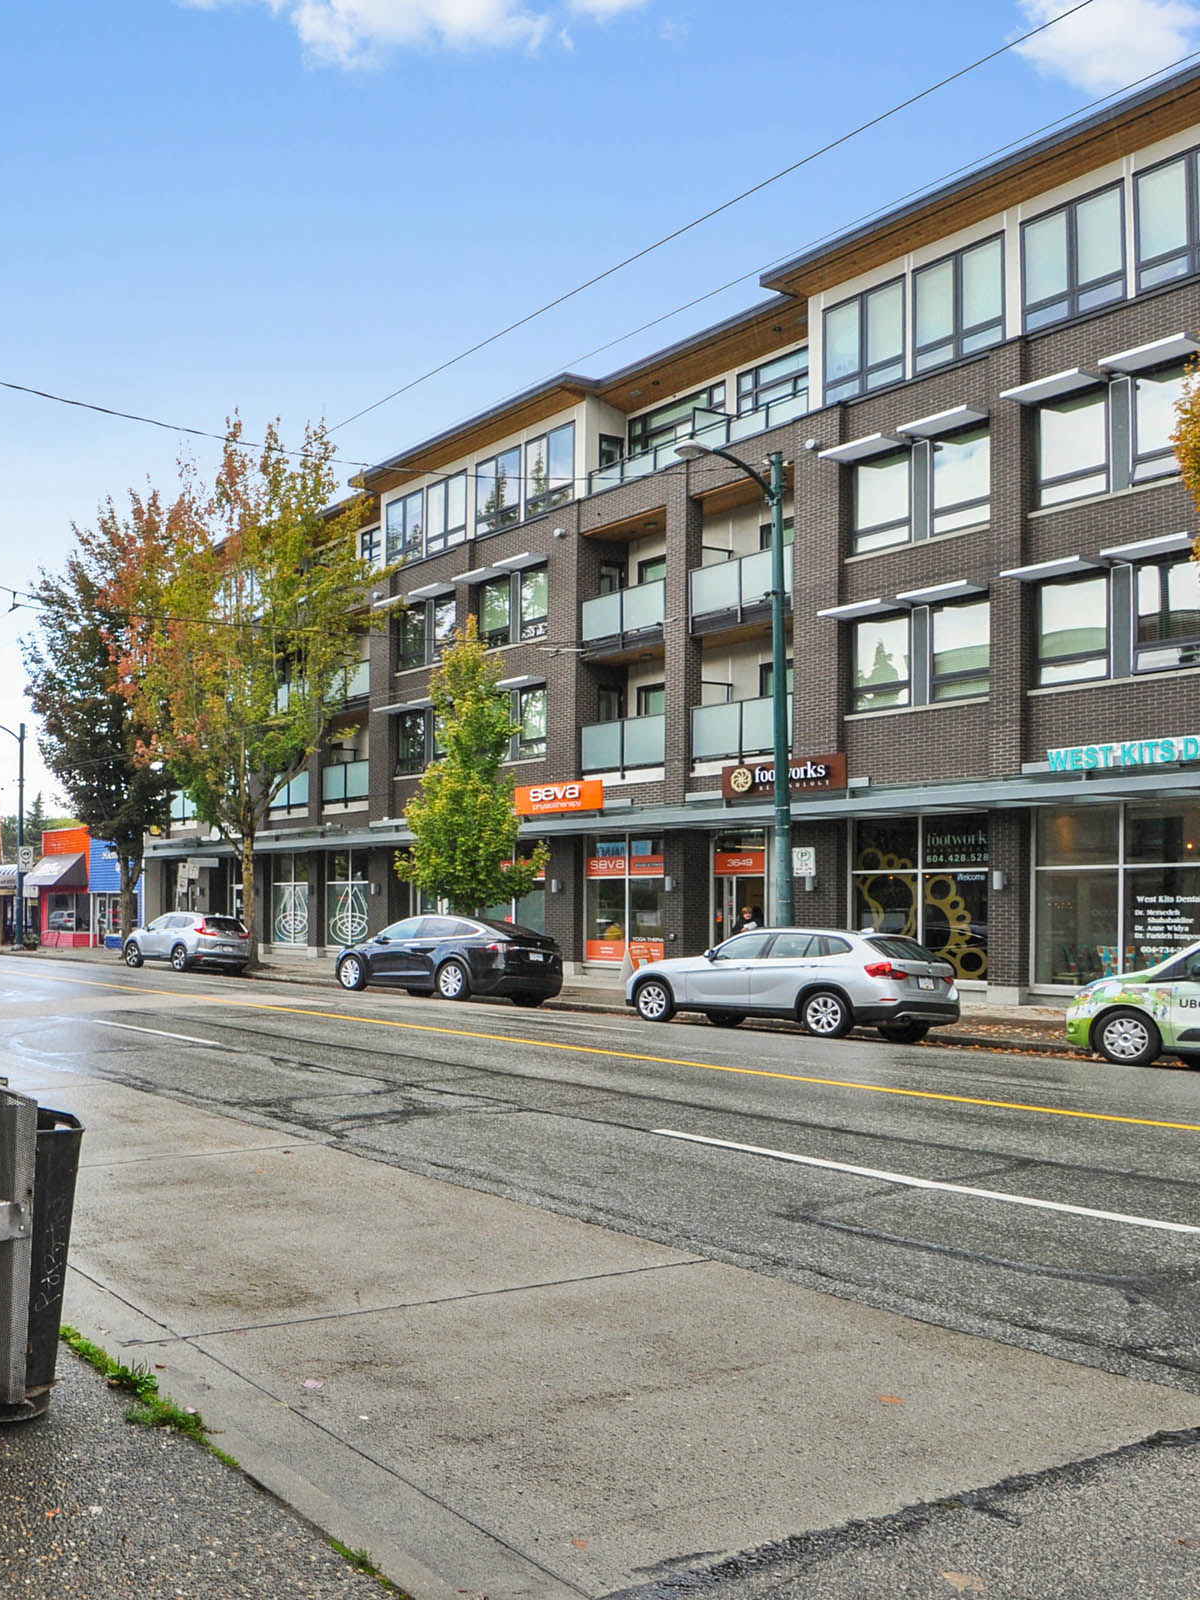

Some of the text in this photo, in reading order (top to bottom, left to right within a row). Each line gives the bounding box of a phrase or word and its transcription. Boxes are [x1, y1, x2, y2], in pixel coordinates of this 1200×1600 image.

[1048, 745, 1113, 772] WEST
[1121, 739, 1176, 766] KITS
[754, 761, 826, 783] fooorks
[529, 784, 581, 802] seva
[590, 860, 625, 870] seva
[1136, 895, 1157, 903] West
[1158, 895, 1175, 903] Kits
